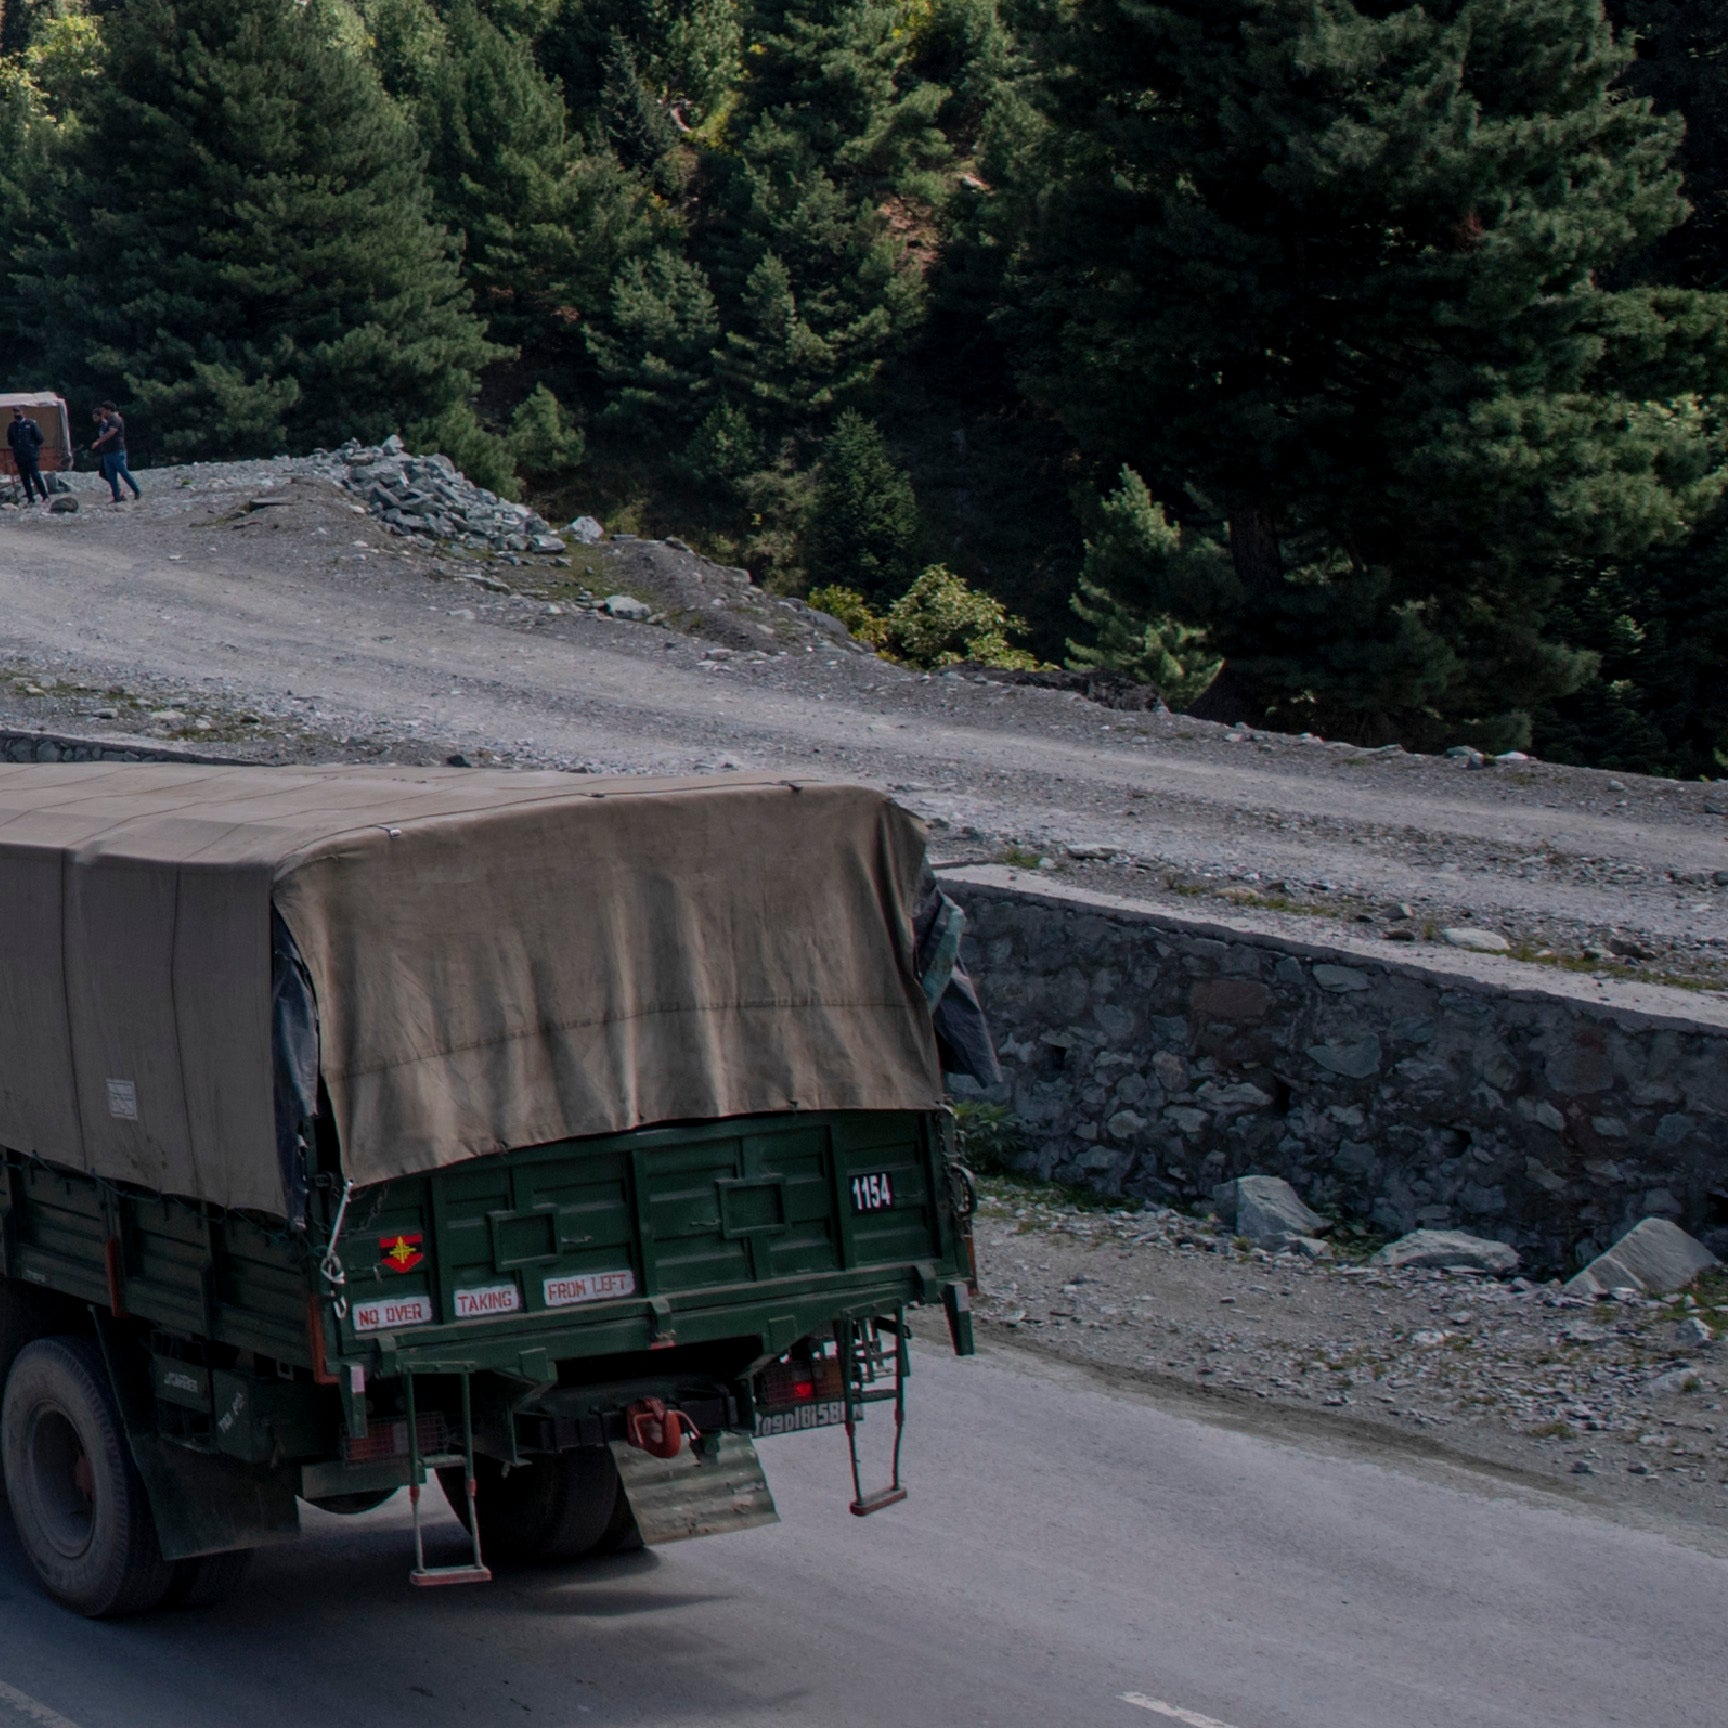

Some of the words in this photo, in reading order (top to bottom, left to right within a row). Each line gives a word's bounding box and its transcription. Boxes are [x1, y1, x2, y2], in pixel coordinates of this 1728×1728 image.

[852, 1173, 892, 1211] 1154
[547, 1279, 586, 1301] FROM
[591, 1274, 627, 1294] LEFT
[358, 1308, 379, 1327] NO
[385, 1302, 423, 1323] OVER
[457, 1290, 513, 1314] TAKING
